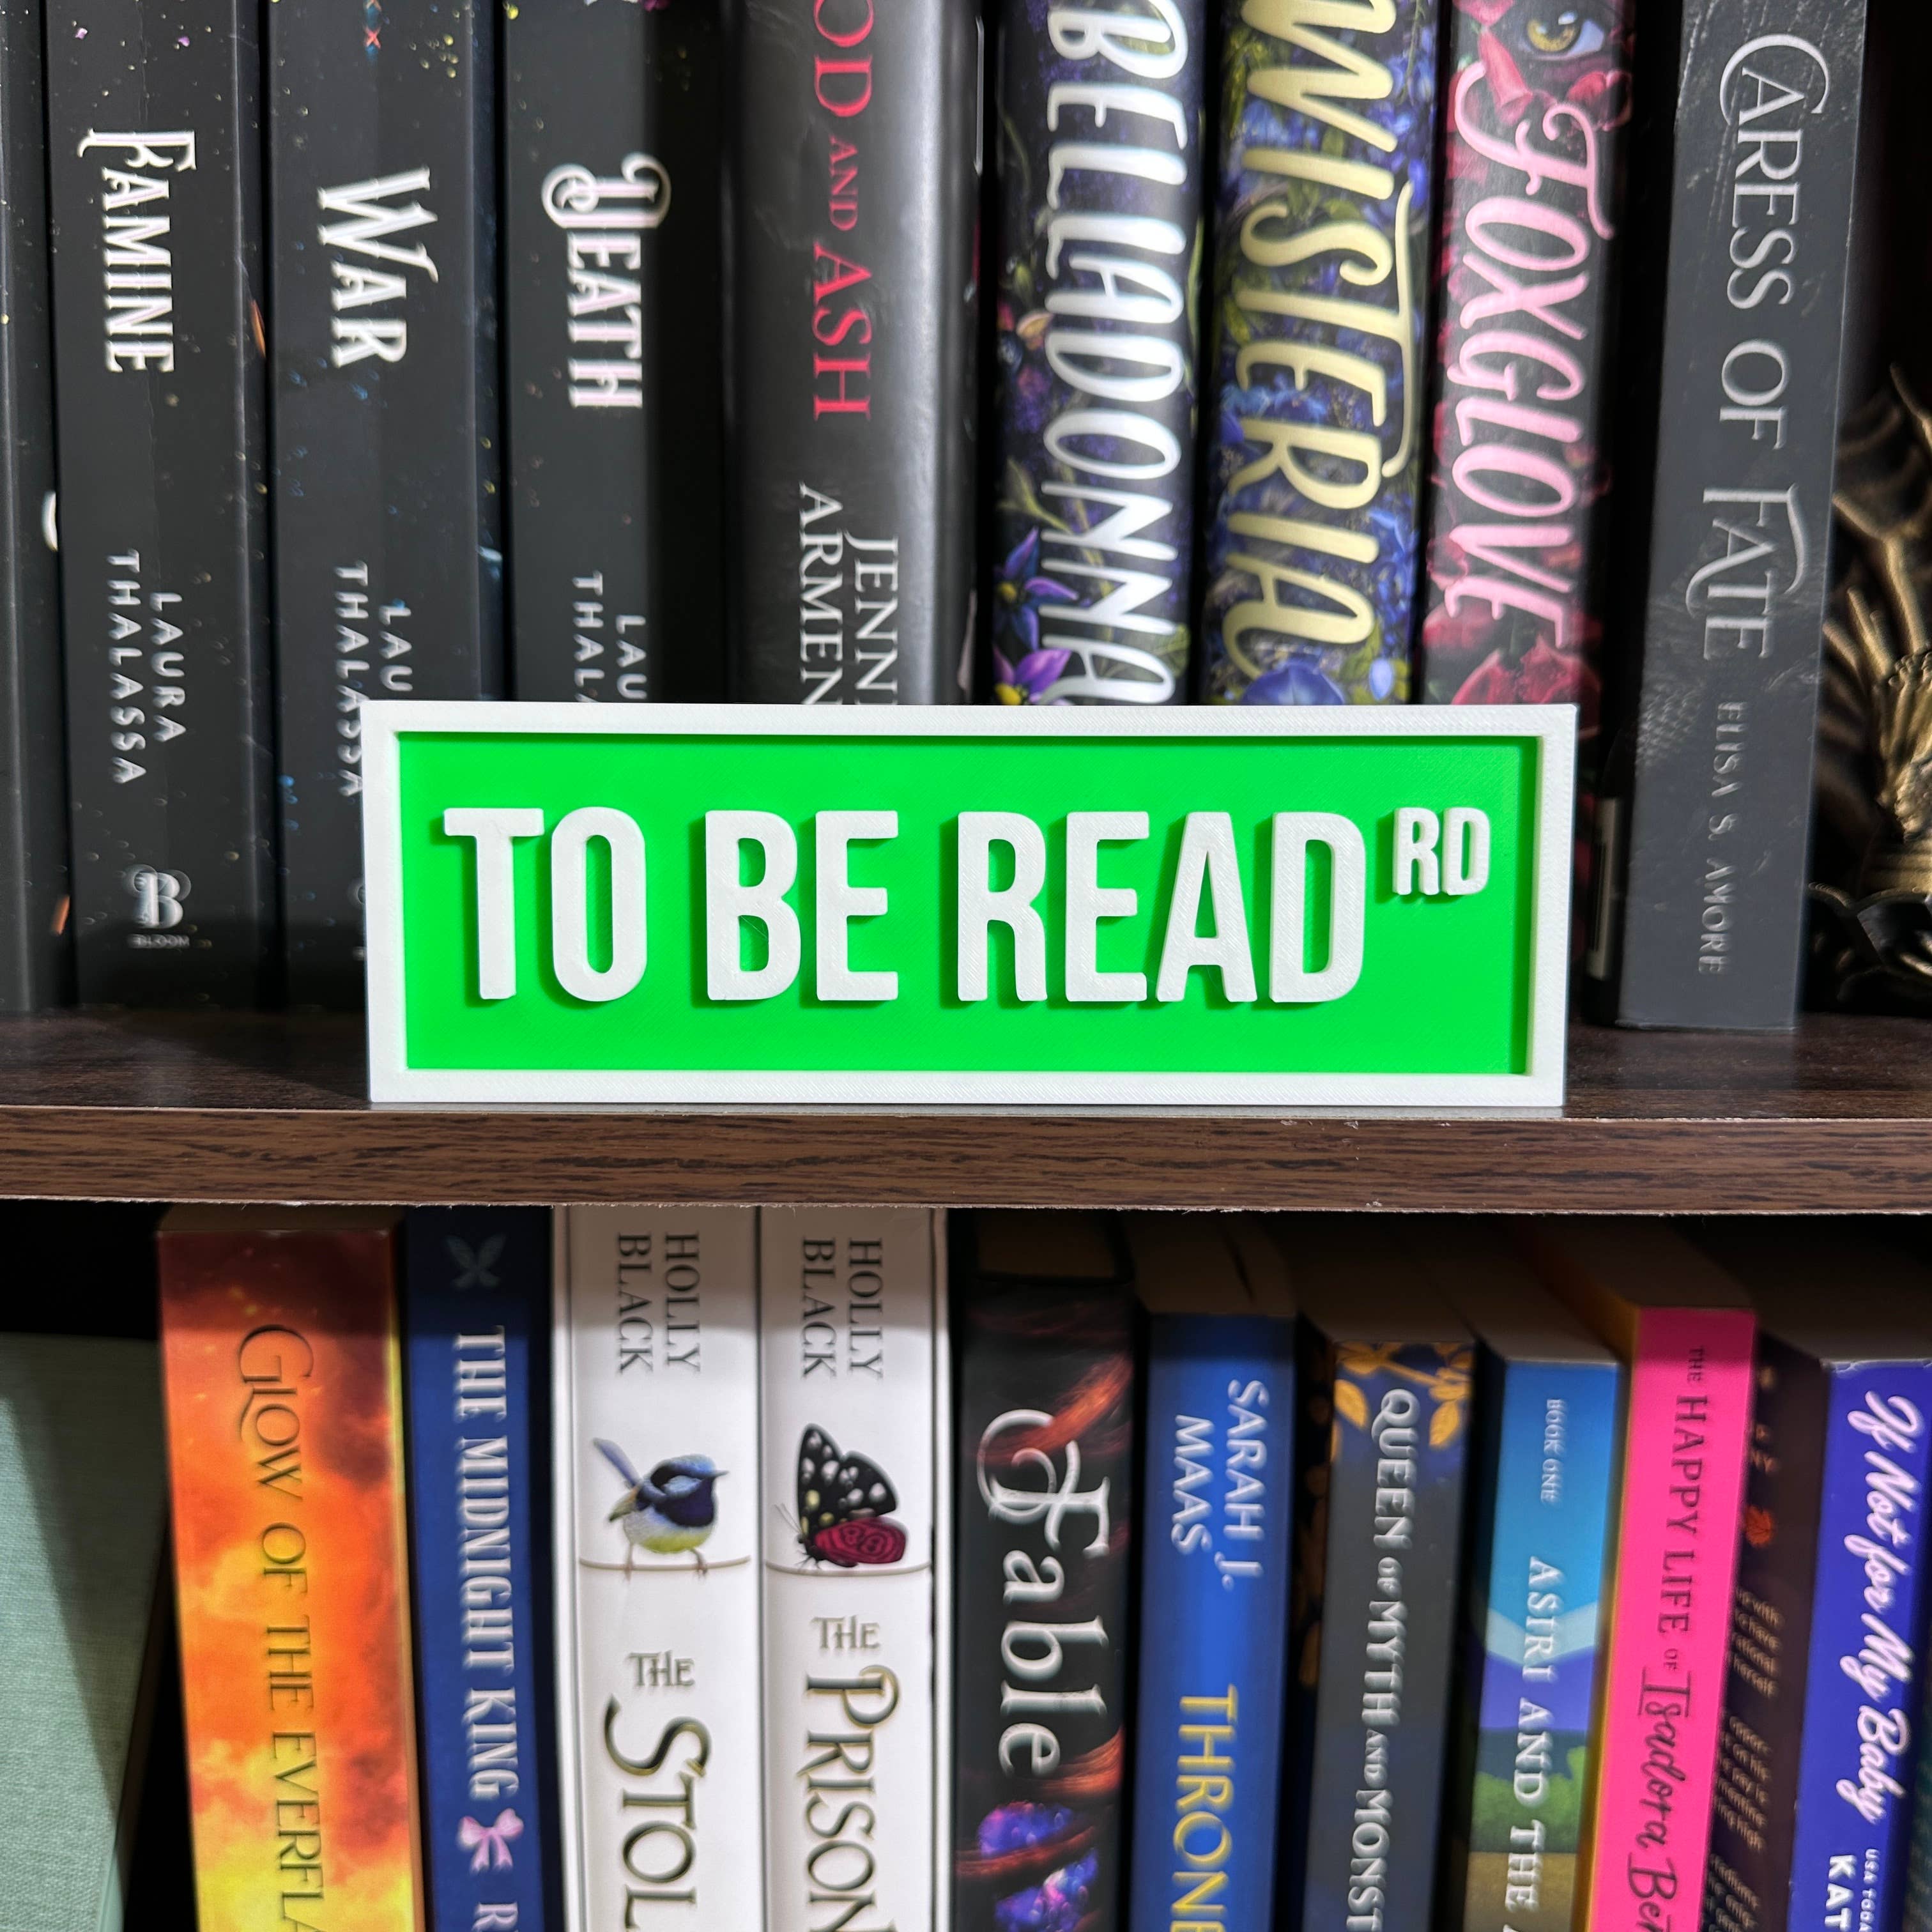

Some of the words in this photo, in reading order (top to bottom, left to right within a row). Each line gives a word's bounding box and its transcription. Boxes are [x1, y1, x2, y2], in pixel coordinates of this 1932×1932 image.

[829, 132, 859, 231] AND
[1719, 33, 1829, 309] CARESS
[77, 128, 197, 372] FAMINE
[318, 165, 438, 369] WAR
[541, 152, 671, 408] DEATH
[812, 241, 872, 421] ASH
[1038, 0, 1188, 703] BELLADONNA
[1222, 0, 1413, 678] WISTERIA
[1445, 61, 1615, 647] FOXGLOVE
[1720, 338, 1790, 450] OF
[843, 530, 898, 704] JENN
[1685, 483, 1807, 659] FATE
[107, 548, 146, 783] THALASSA
[150, 592, 187, 742] LAURA
[1711, 702, 1749, 798] ELISA
[443, 806, 647, 1002] TO
[705, 811, 898, 1001] BE
[958, 811, 1366, 1002] READ
[1392, 807, 1491, 895] RD
[1698, 858, 1736, 975] AMORE
[617, 1232, 653, 1375] BLACK
[664, 1231, 701, 1372] HOLLY
[801, 1237, 836, 1379] BLACK
[848, 1238, 884, 1379] HOLLY
[1687, 1346, 1705, 1383] THE
[238, 1324, 314, 1500] GLOW
[454, 1325, 507, 1422] THE
[1544, 1399, 1567, 1457] BOOK
[1847, 1390, 1924, 1453] If
[1170, 1414, 1213, 1554] MAAS
[1223, 1380, 1270, 1541] SARAH
[1371, 1388, 1420, 1549] QUEEN
[1540, 1458, 1563, 1504] ONE
[1666, 1395, 1708, 1534] HAPPY
[1864, 1450, 1921, 1549] Not
[261, 1522, 308, 1596] OF
[456, 1435, 514, 1676] MIDNIGHT
[977, 1409, 1110, 1777] Fable
[1214, 1551, 1263, 1590] J.
[1377, 1556, 1402, 1597] OF
[1657, 1549, 1694, 1634] LIFE
[1843, 1533, 1910, 1614] for
[266, 1614, 314, 1712] THE
[628, 1650, 696, 1687] THE
[811, 1615, 881, 1650] THE
[1361, 1600, 1407, 1725] MYTH
[1839, 1613, 1914, 1703] My
[462, 1687, 519, 1801] KING
[796, 1664, 900, 1932] PRISON
[1363, 1729, 1389, 1788] AND
[1514, 1697, 1554, 1807] AND
[1636, 1666, 1691, 1848] Isadora
[1836, 1705, 1911, 1825] Baby
[604, 1694, 712, 1932] STOL
[1505, 1820, 1546, 1912] THE
[1863, 1848, 1880, 1884] USA
[1824, 1855, 1857, 1932] KAT
